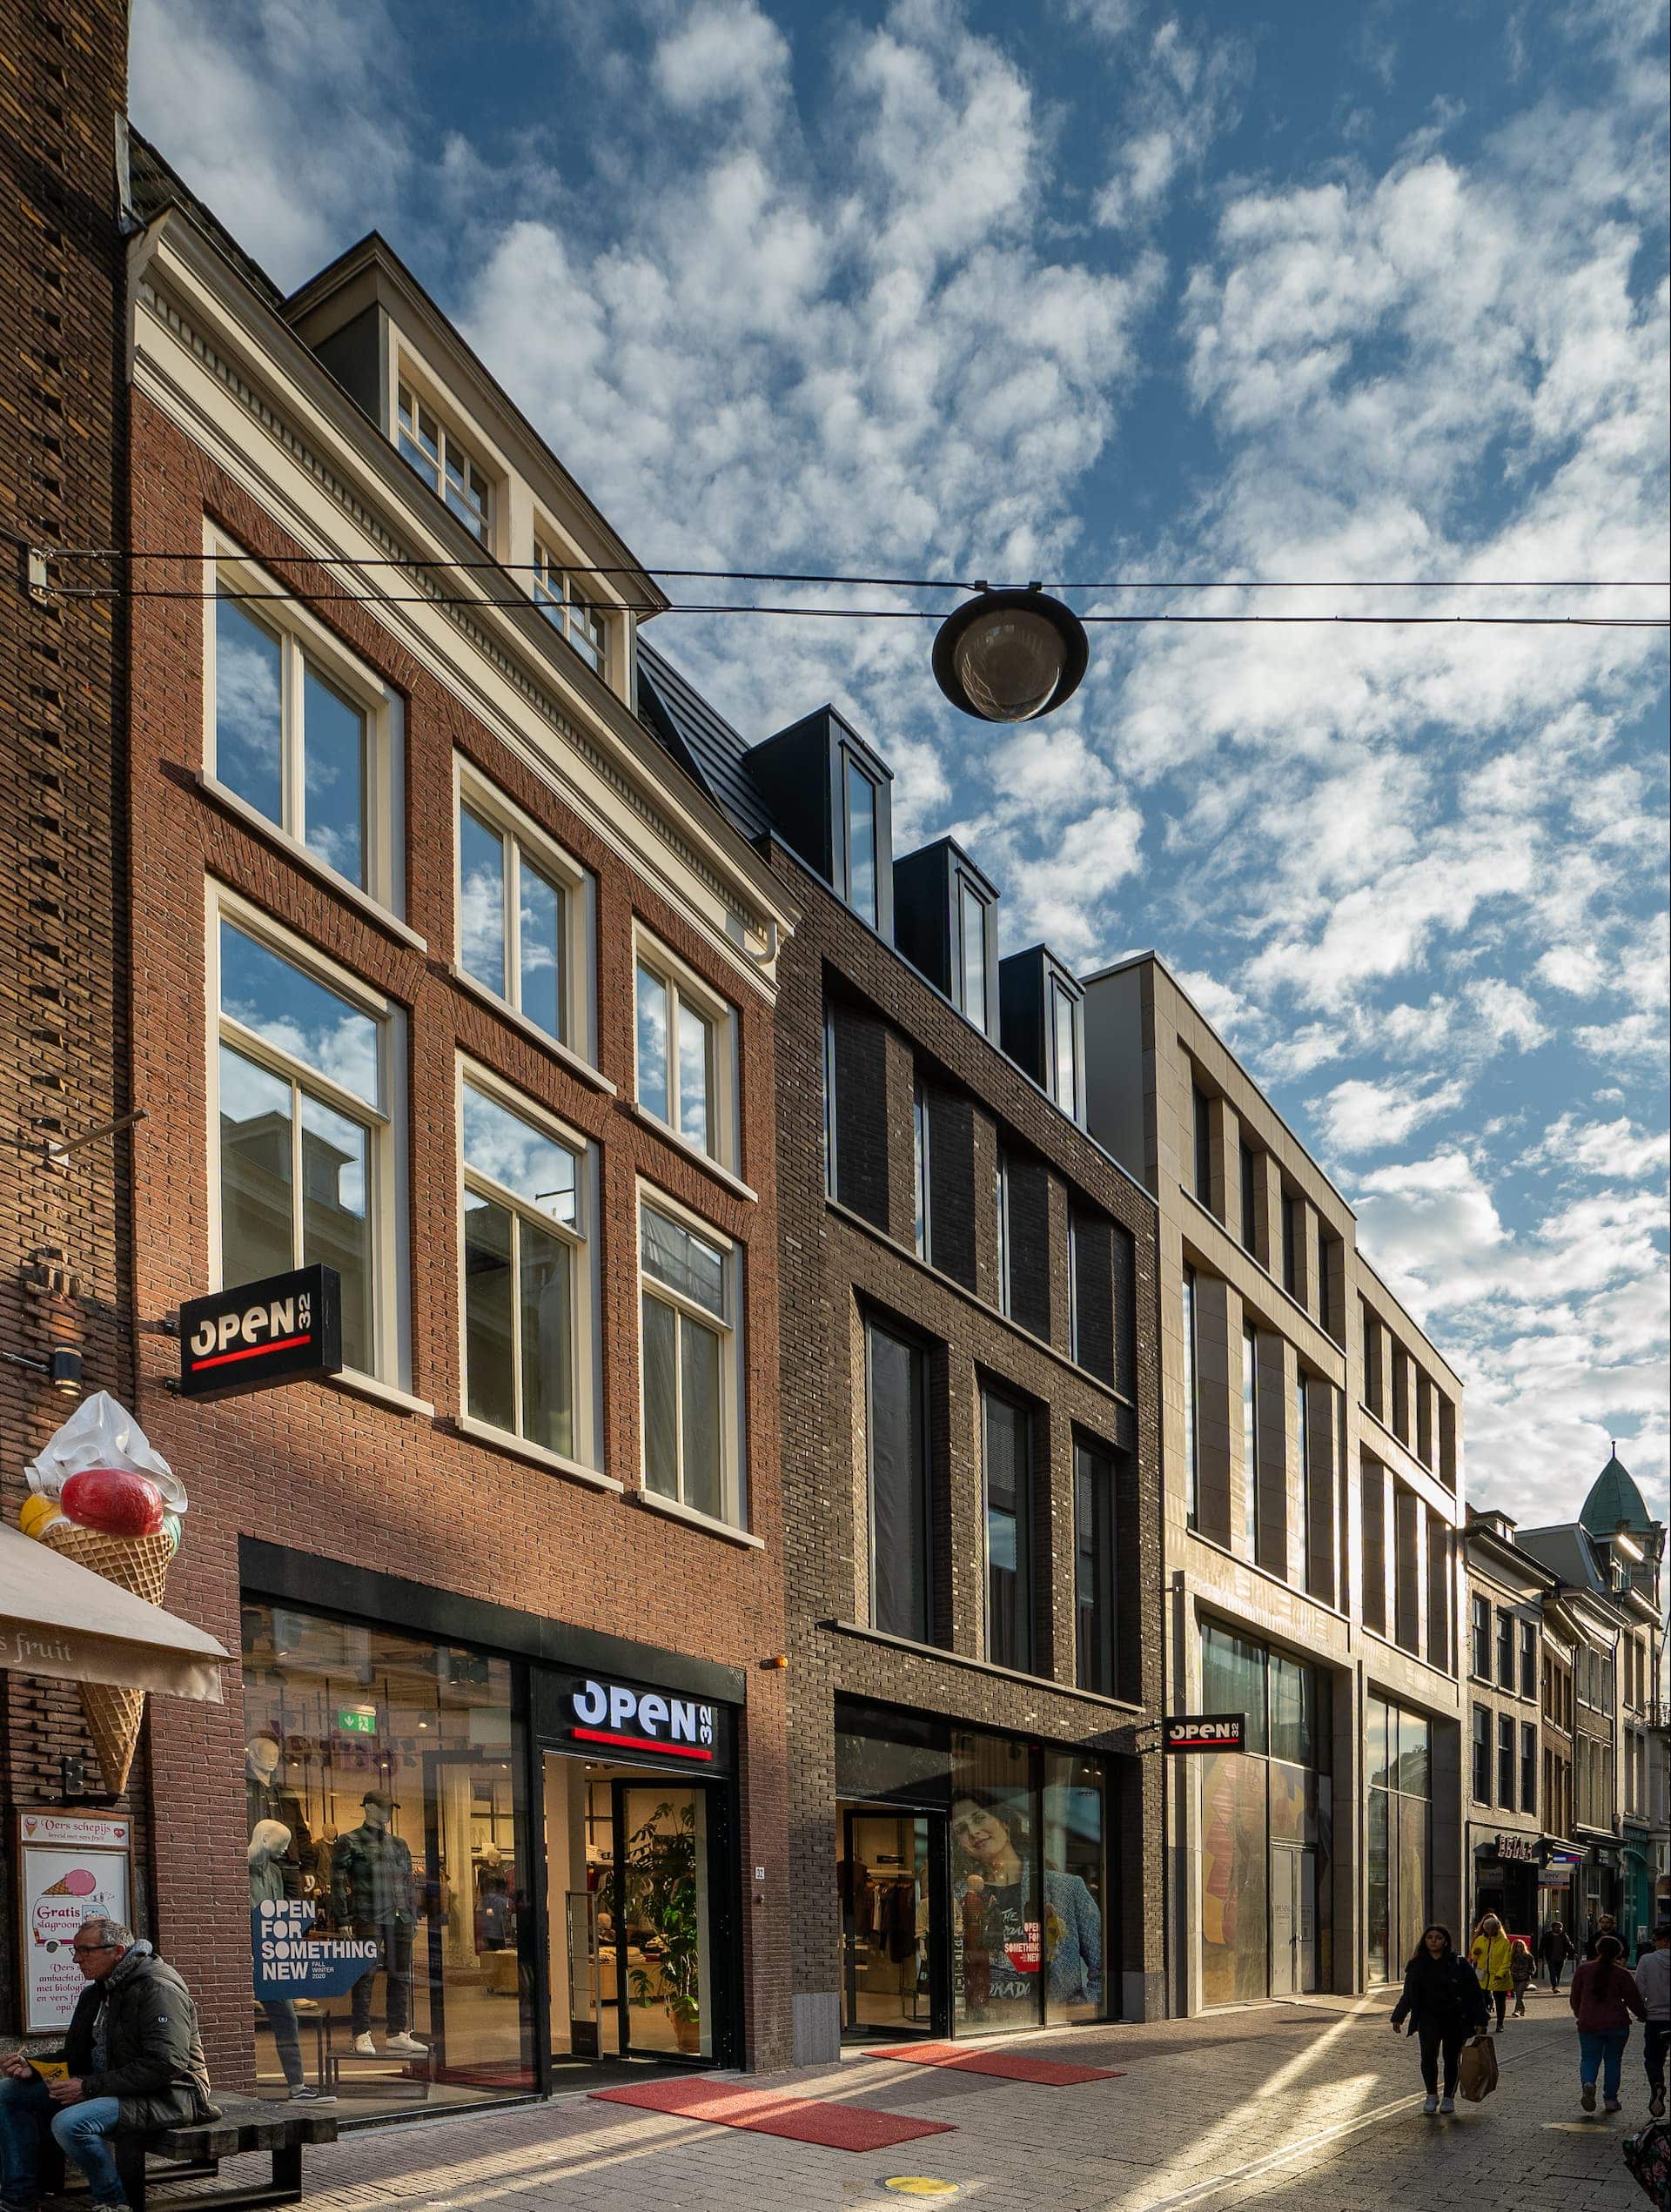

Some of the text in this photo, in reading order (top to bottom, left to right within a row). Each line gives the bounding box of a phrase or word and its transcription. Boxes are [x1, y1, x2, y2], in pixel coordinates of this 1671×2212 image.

[299, 1292, 311, 1330] 32
[14, 1632, 73, 1663] fruit
[700, 1706, 712, 1745] 32
[41, 1820, 111, 1835] Vers schepijs
[37, 1906, 81, 1920] Gratis
[260, 1900, 316, 1918] OPEN
[261, 1920, 302, 1939] FOR
[261, 1941, 378, 1960] SOMETHING
[263, 1961, 309, 1981] NEW
